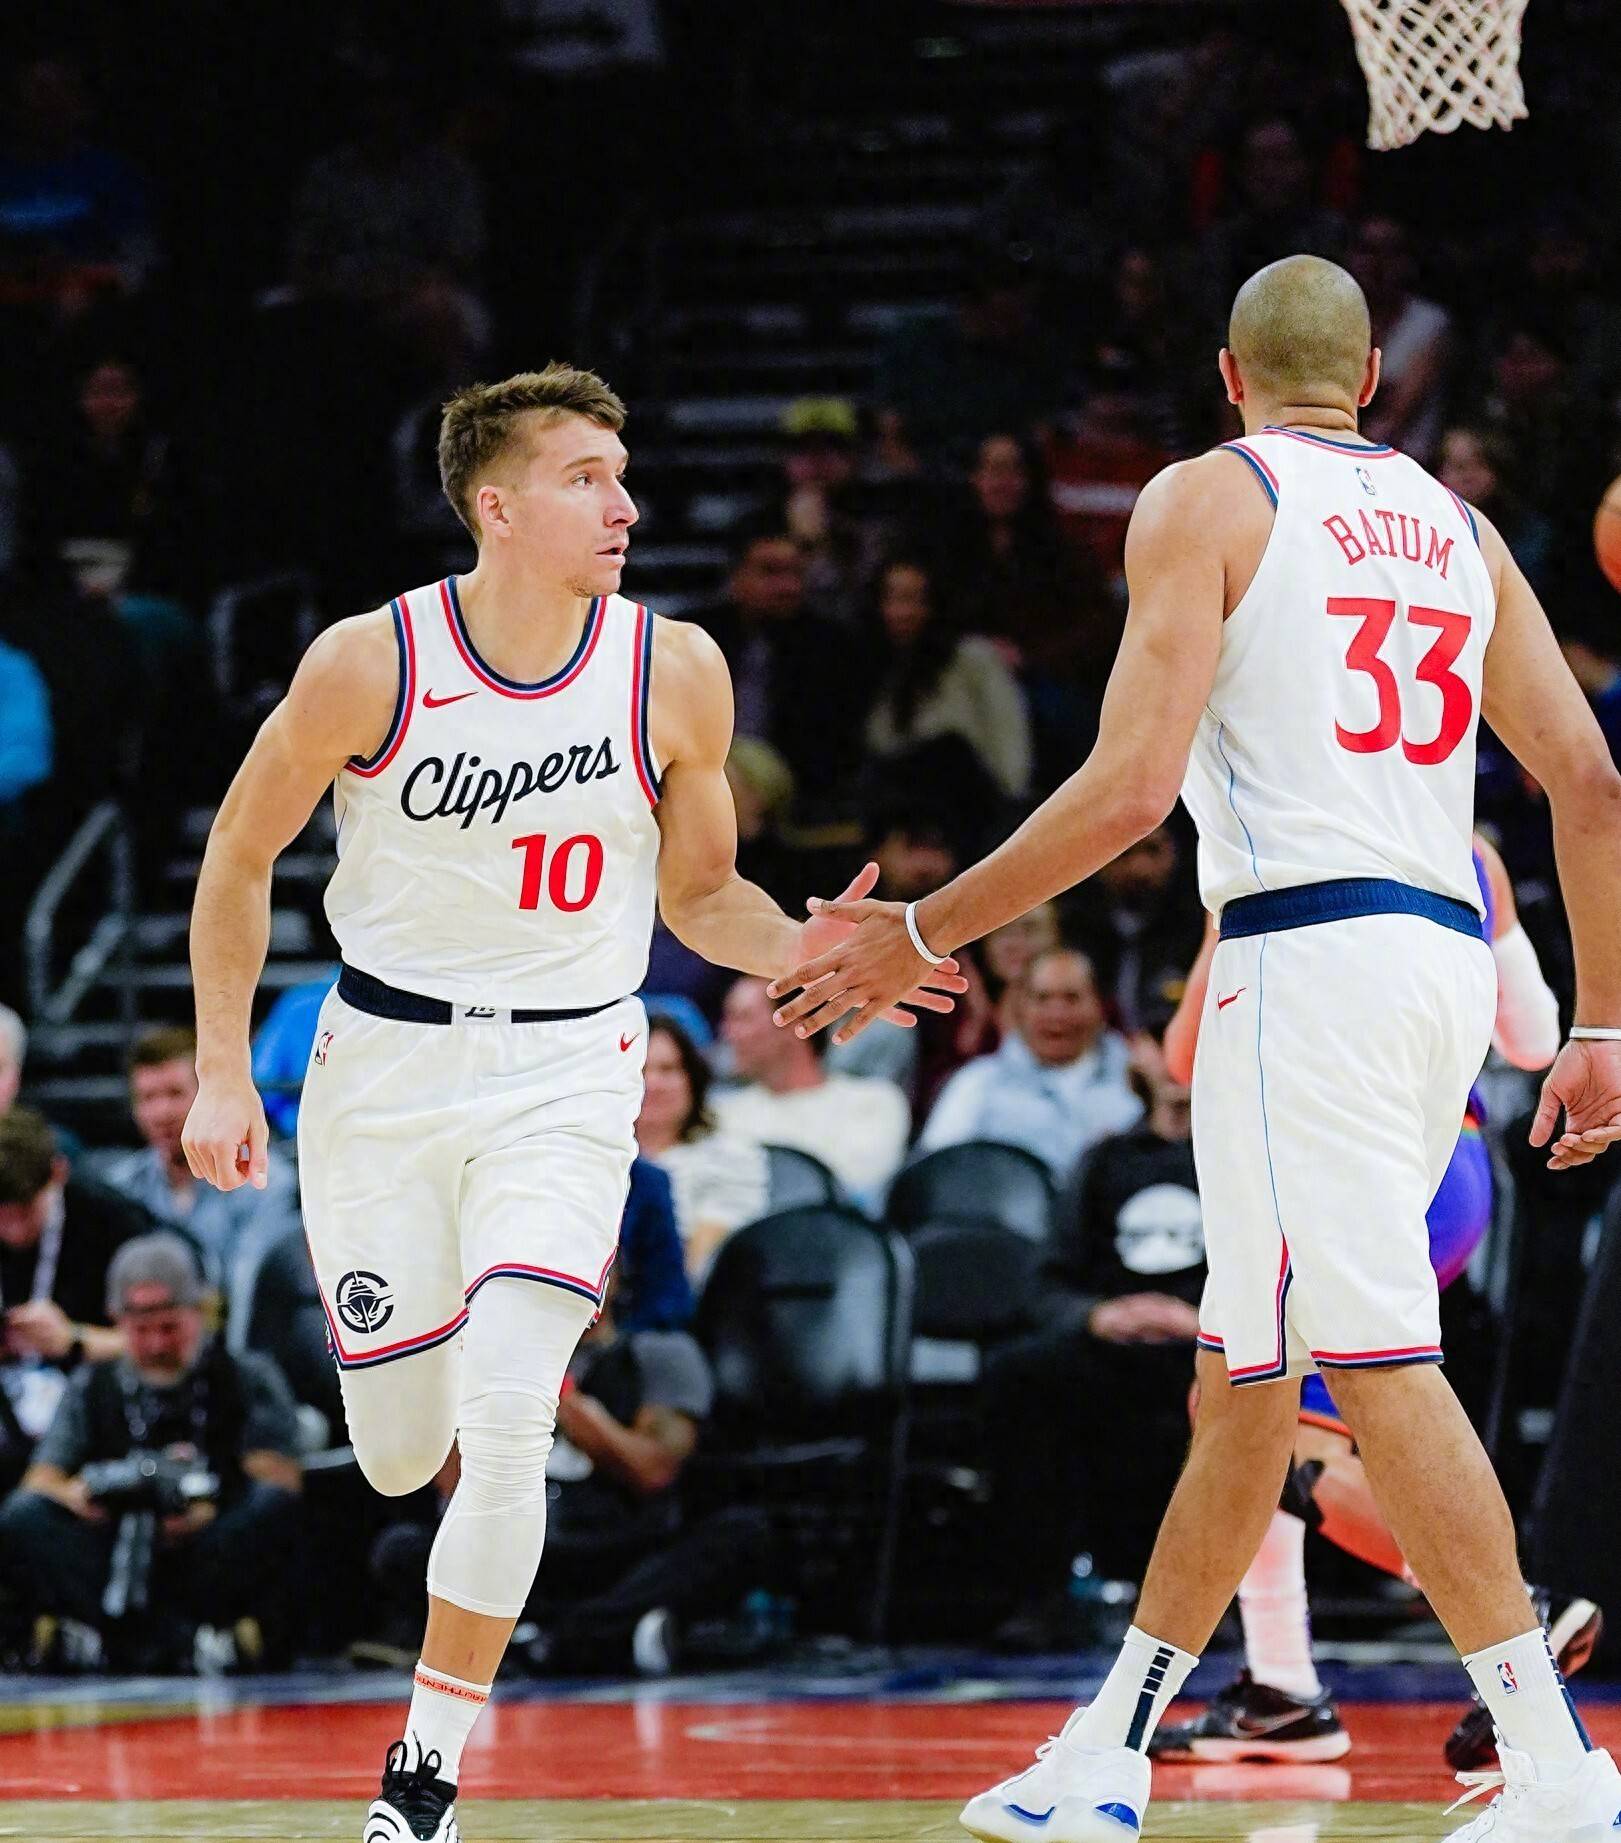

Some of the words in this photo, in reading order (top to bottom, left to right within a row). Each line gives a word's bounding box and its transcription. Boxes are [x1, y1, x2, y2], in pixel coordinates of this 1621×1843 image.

[1322, 508, 1455, 580] BATUM
[1326, 596, 1474, 766] 33
[400, 735, 622, 830] Clippers
[511, 832, 605, 913] 10
